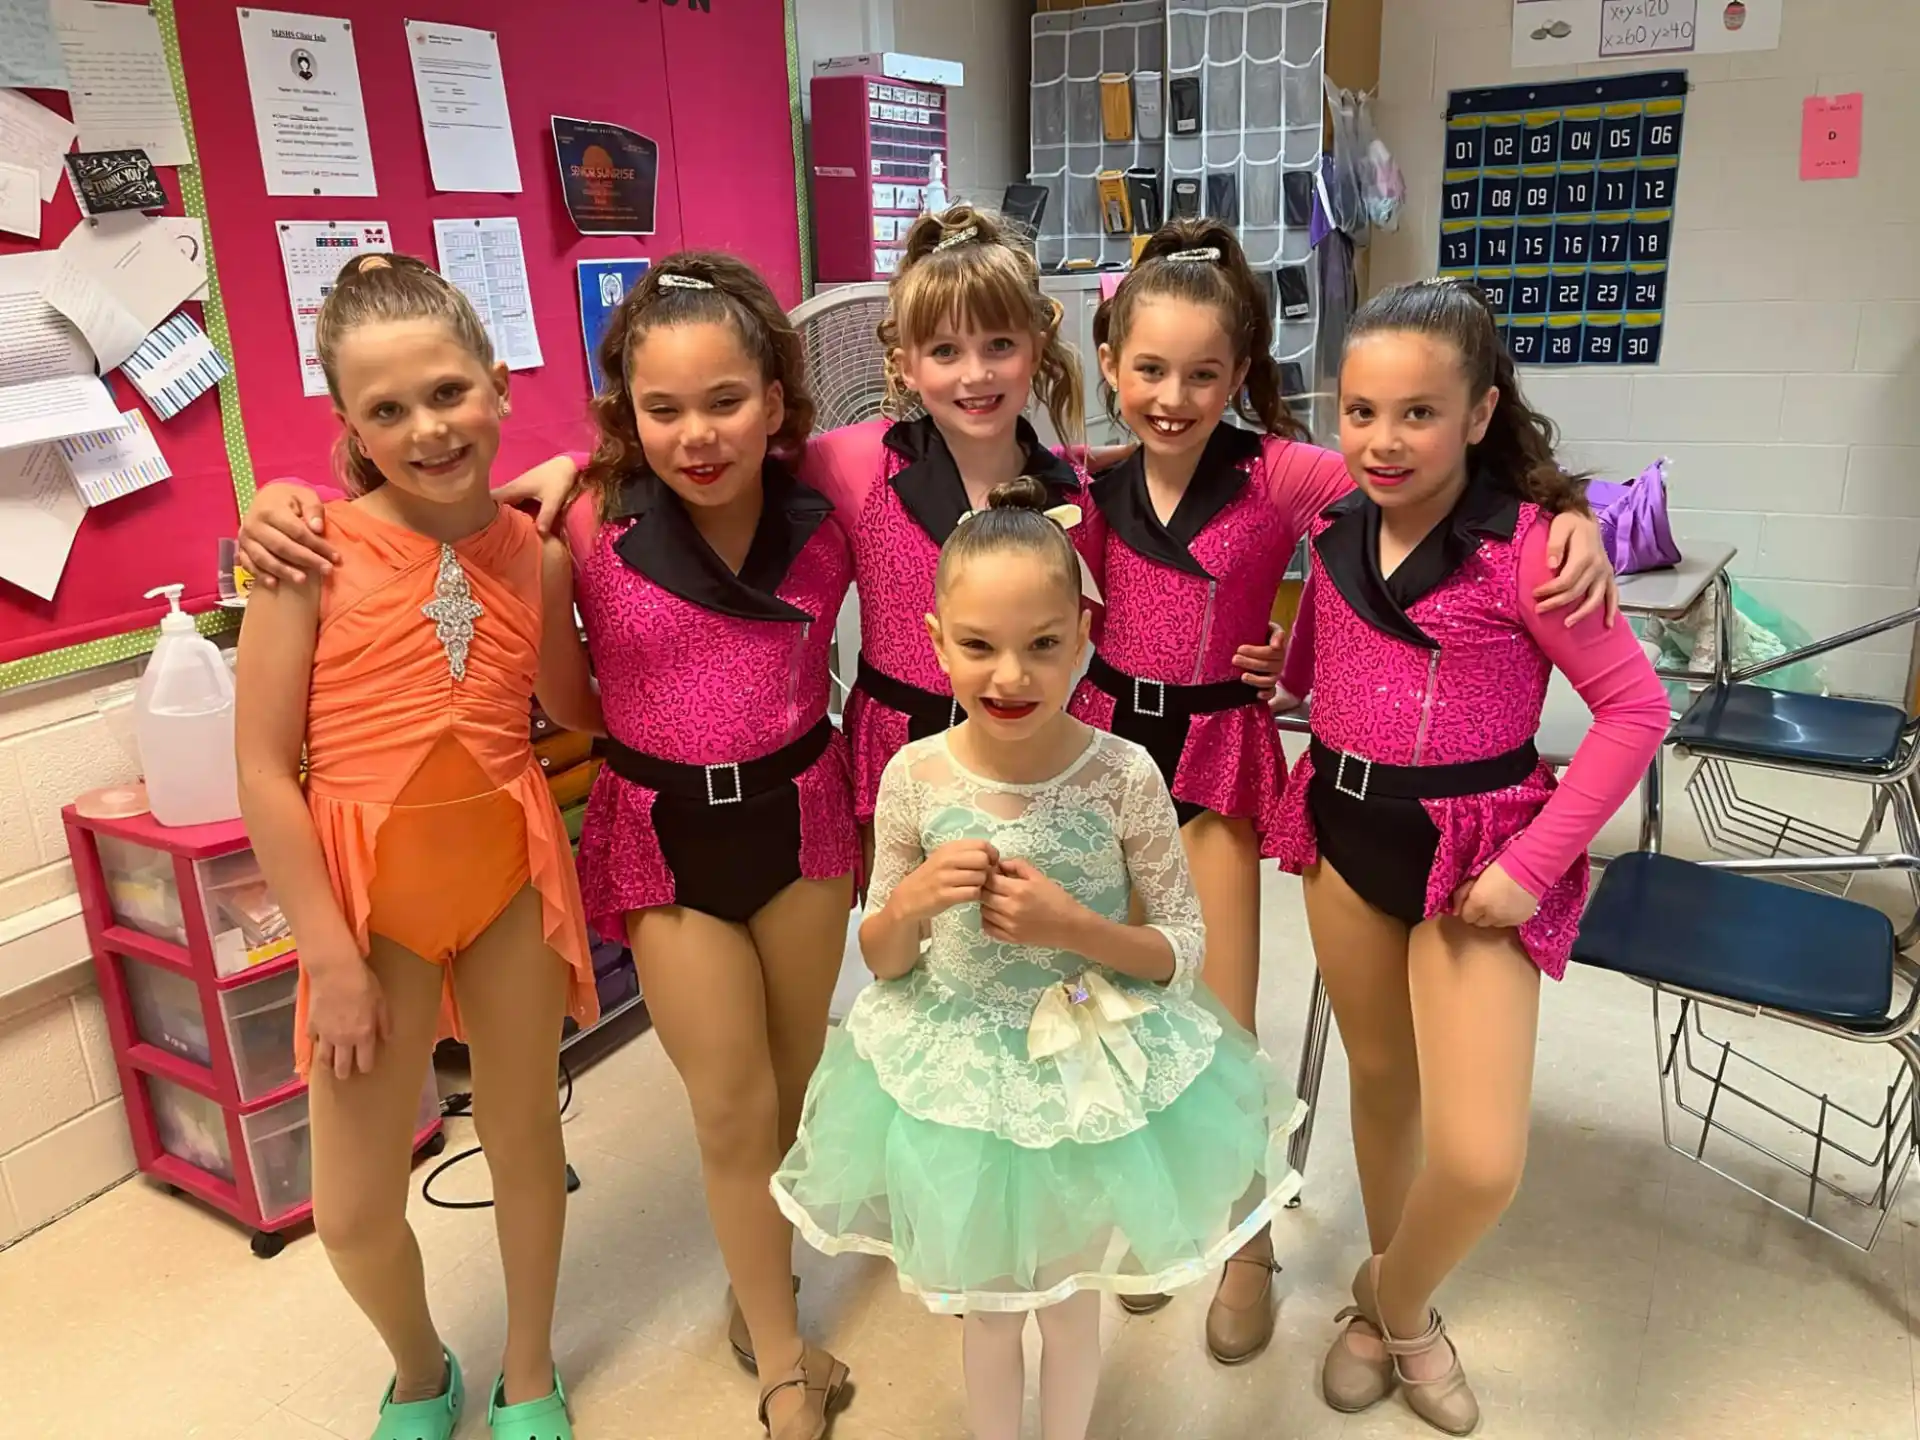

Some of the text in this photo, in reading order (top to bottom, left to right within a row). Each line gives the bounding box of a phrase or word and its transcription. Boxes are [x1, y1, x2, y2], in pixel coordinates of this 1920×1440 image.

[1455, 126, 1672, 160] 01 02 03 04 05 06
[1828, 131, 1837, 140] D
[92, 168, 141, 194] THANK YOU
[597, 167, 636, 180] SUNRISE
[1451, 181, 1664, 210] 07 08 09 10 11 12
[1448, 235, 1657, 260] 13 14 15 16 17 18
[1485, 285, 1655, 305] 20 21 22 23 24
[1515, 337, 1648, 355] 27 28 29 30
